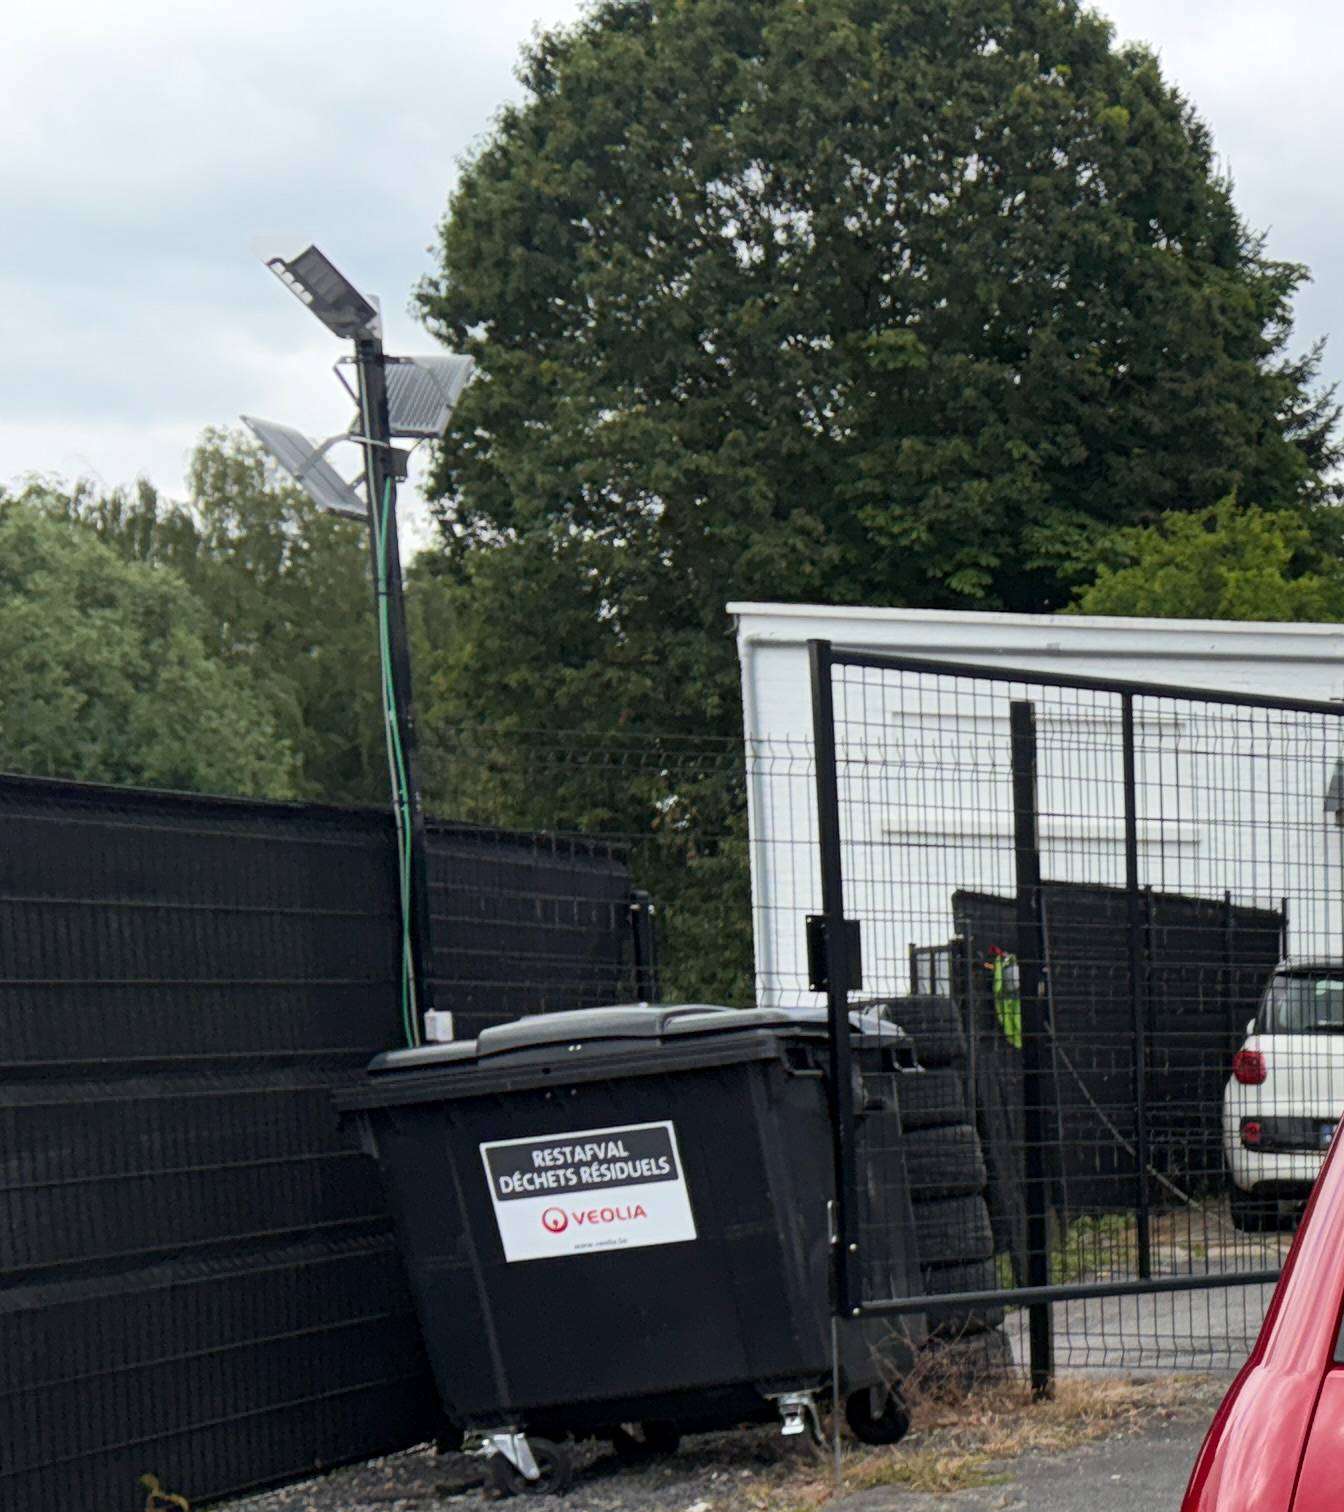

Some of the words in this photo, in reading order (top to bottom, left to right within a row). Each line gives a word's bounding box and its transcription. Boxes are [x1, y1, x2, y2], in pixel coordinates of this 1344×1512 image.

[532, 1140, 629, 1168] RESTAFVAL
[499, 1170, 578, 1194] DÉCHETS
[579, 1156, 671, 1184] RÉSIDUELS
[572, 1204, 647, 1226] VEOLIA
